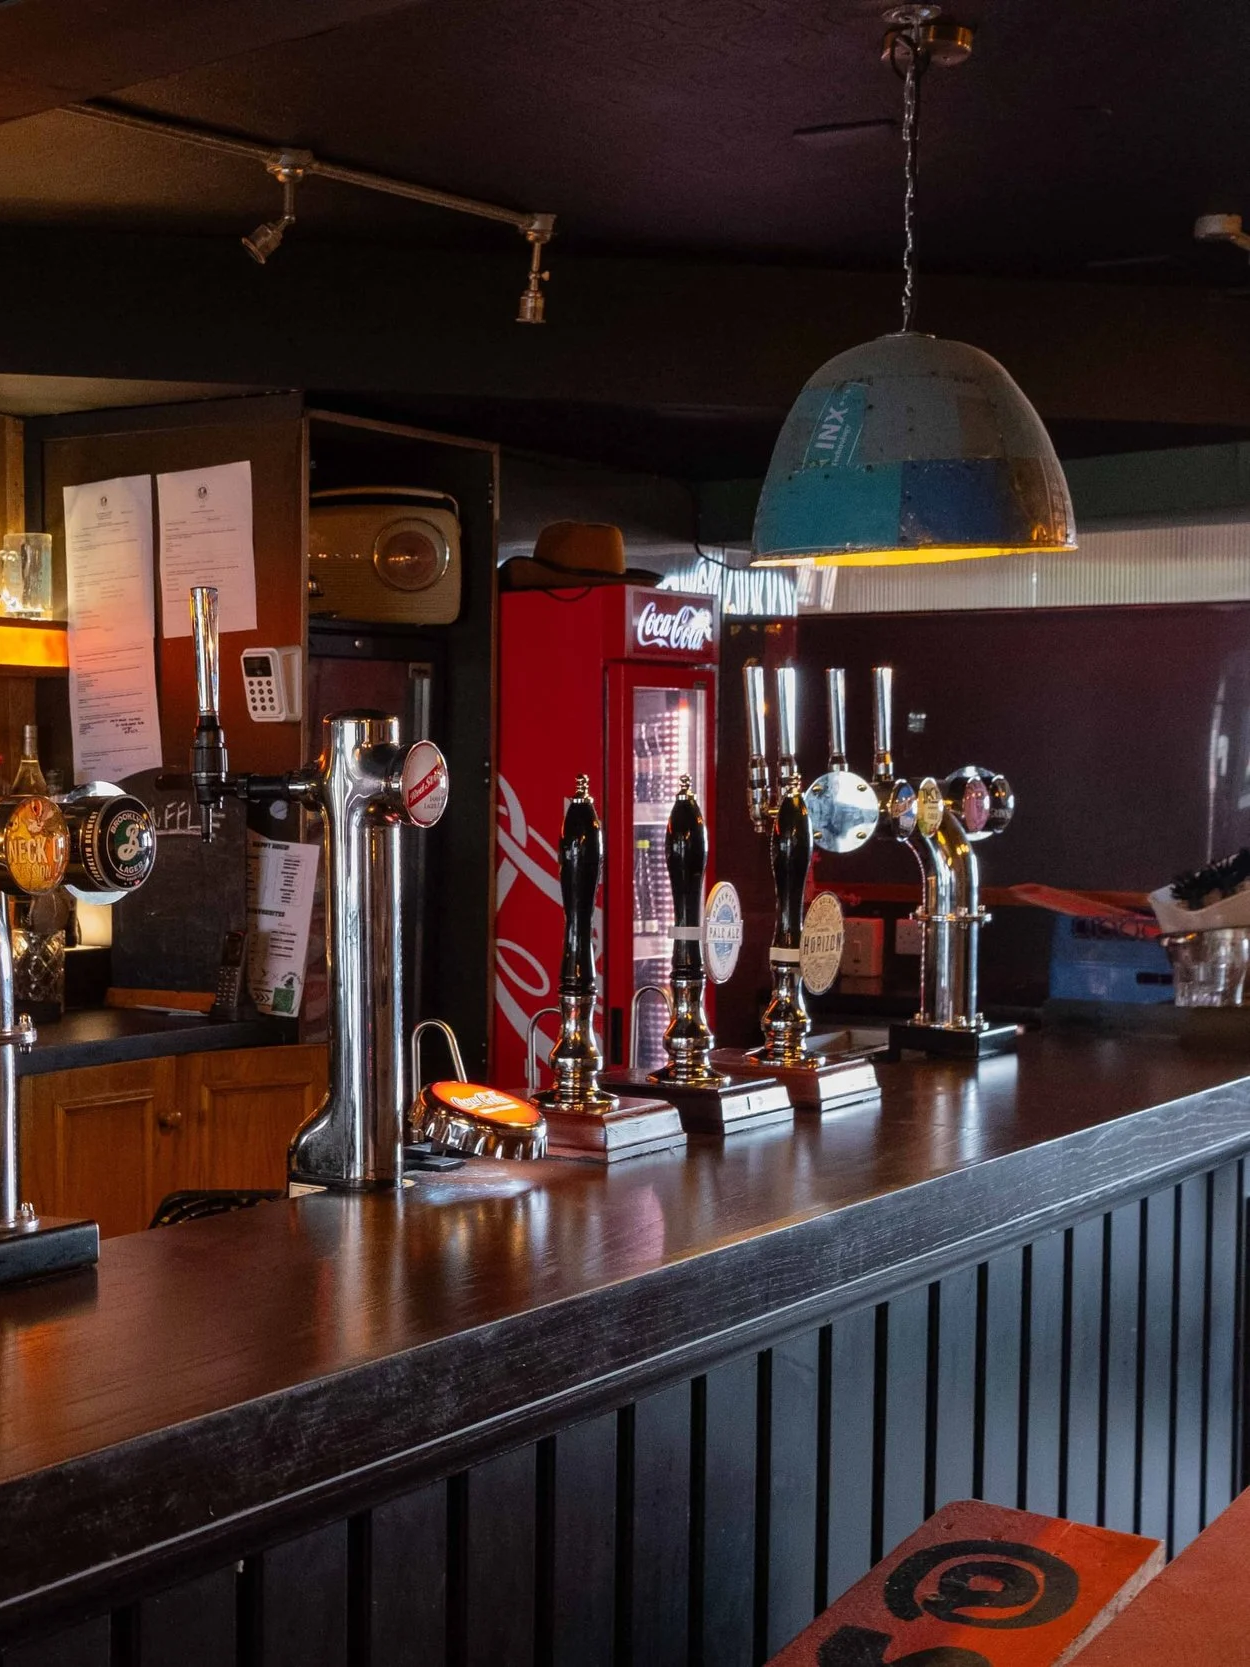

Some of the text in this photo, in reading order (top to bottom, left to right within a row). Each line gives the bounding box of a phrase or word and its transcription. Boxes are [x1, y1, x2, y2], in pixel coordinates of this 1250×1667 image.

[814, 407, 849, 449] INX
[9, 835, 48, 865] NECK
[119, 860, 144, 874] LAGER
[709, 927, 740, 939] PALE ALE
[803, 931, 842, 956] HORIZON
